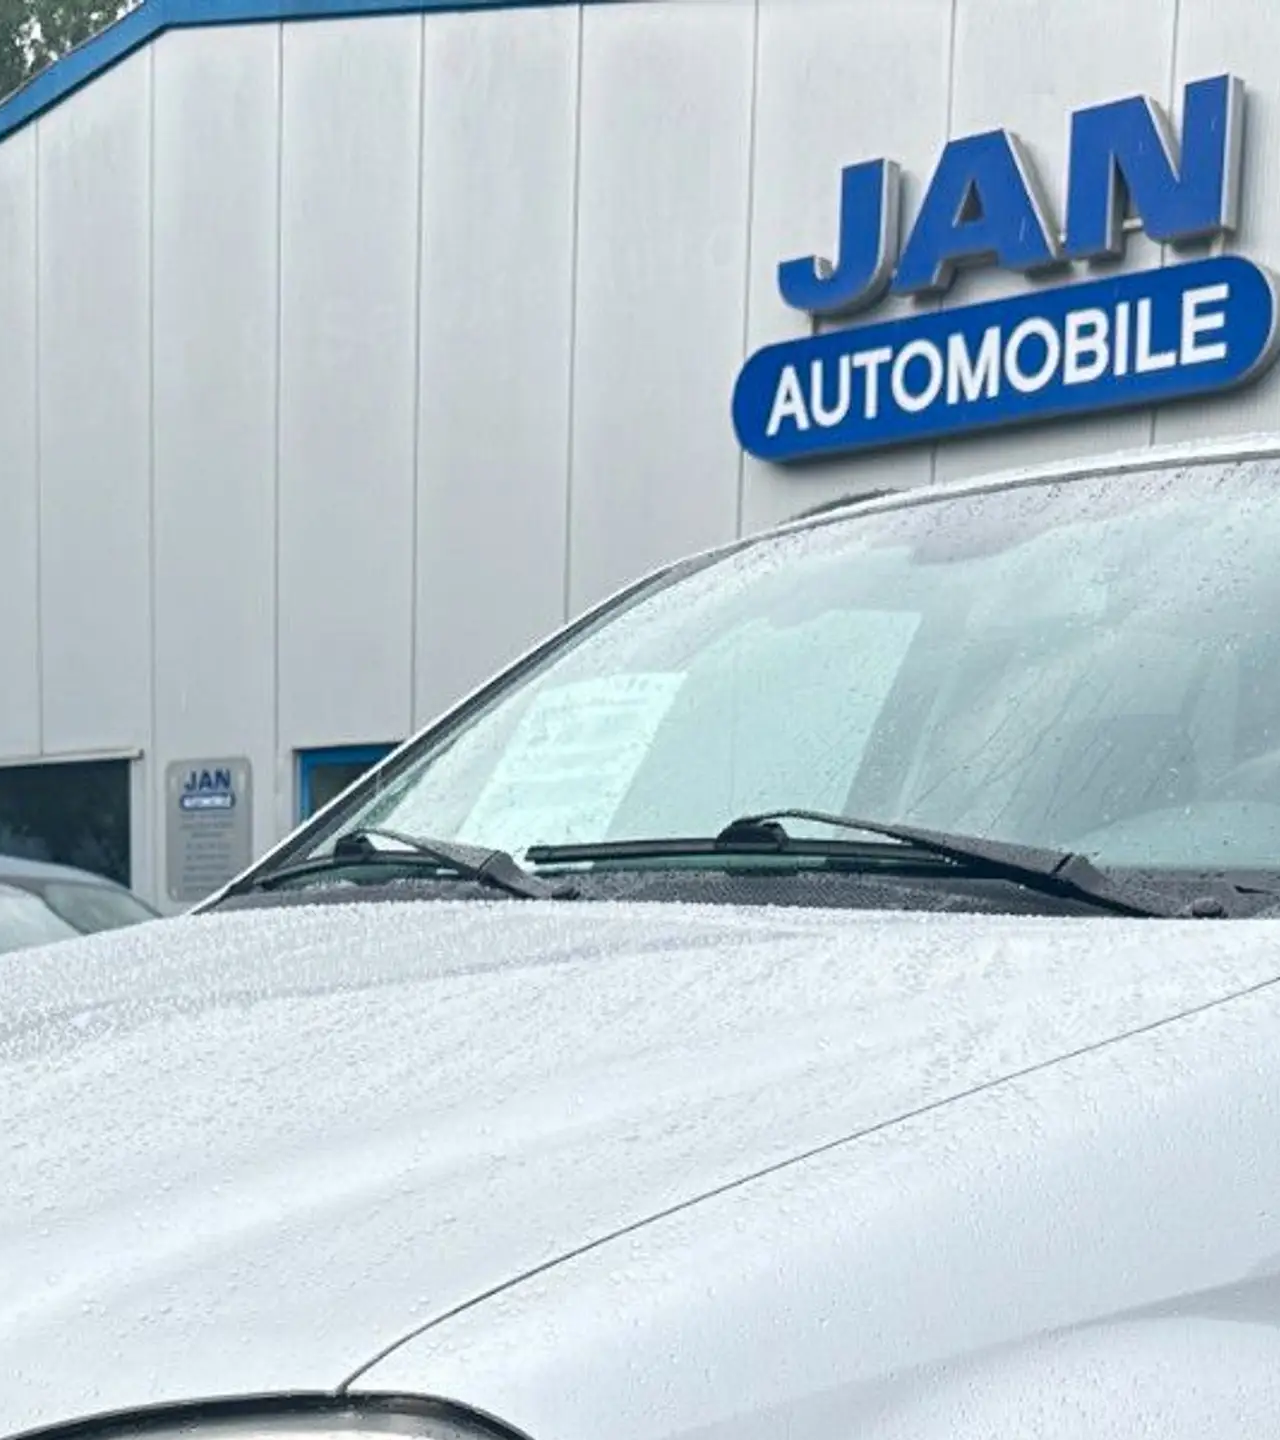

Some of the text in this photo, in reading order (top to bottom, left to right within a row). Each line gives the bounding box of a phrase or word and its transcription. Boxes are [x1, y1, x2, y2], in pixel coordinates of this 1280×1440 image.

[778, 74, 1240, 314] JAN
[766, 284, 1229, 436] AUTOMOBILE
[184, 768, 231, 790] JAN
